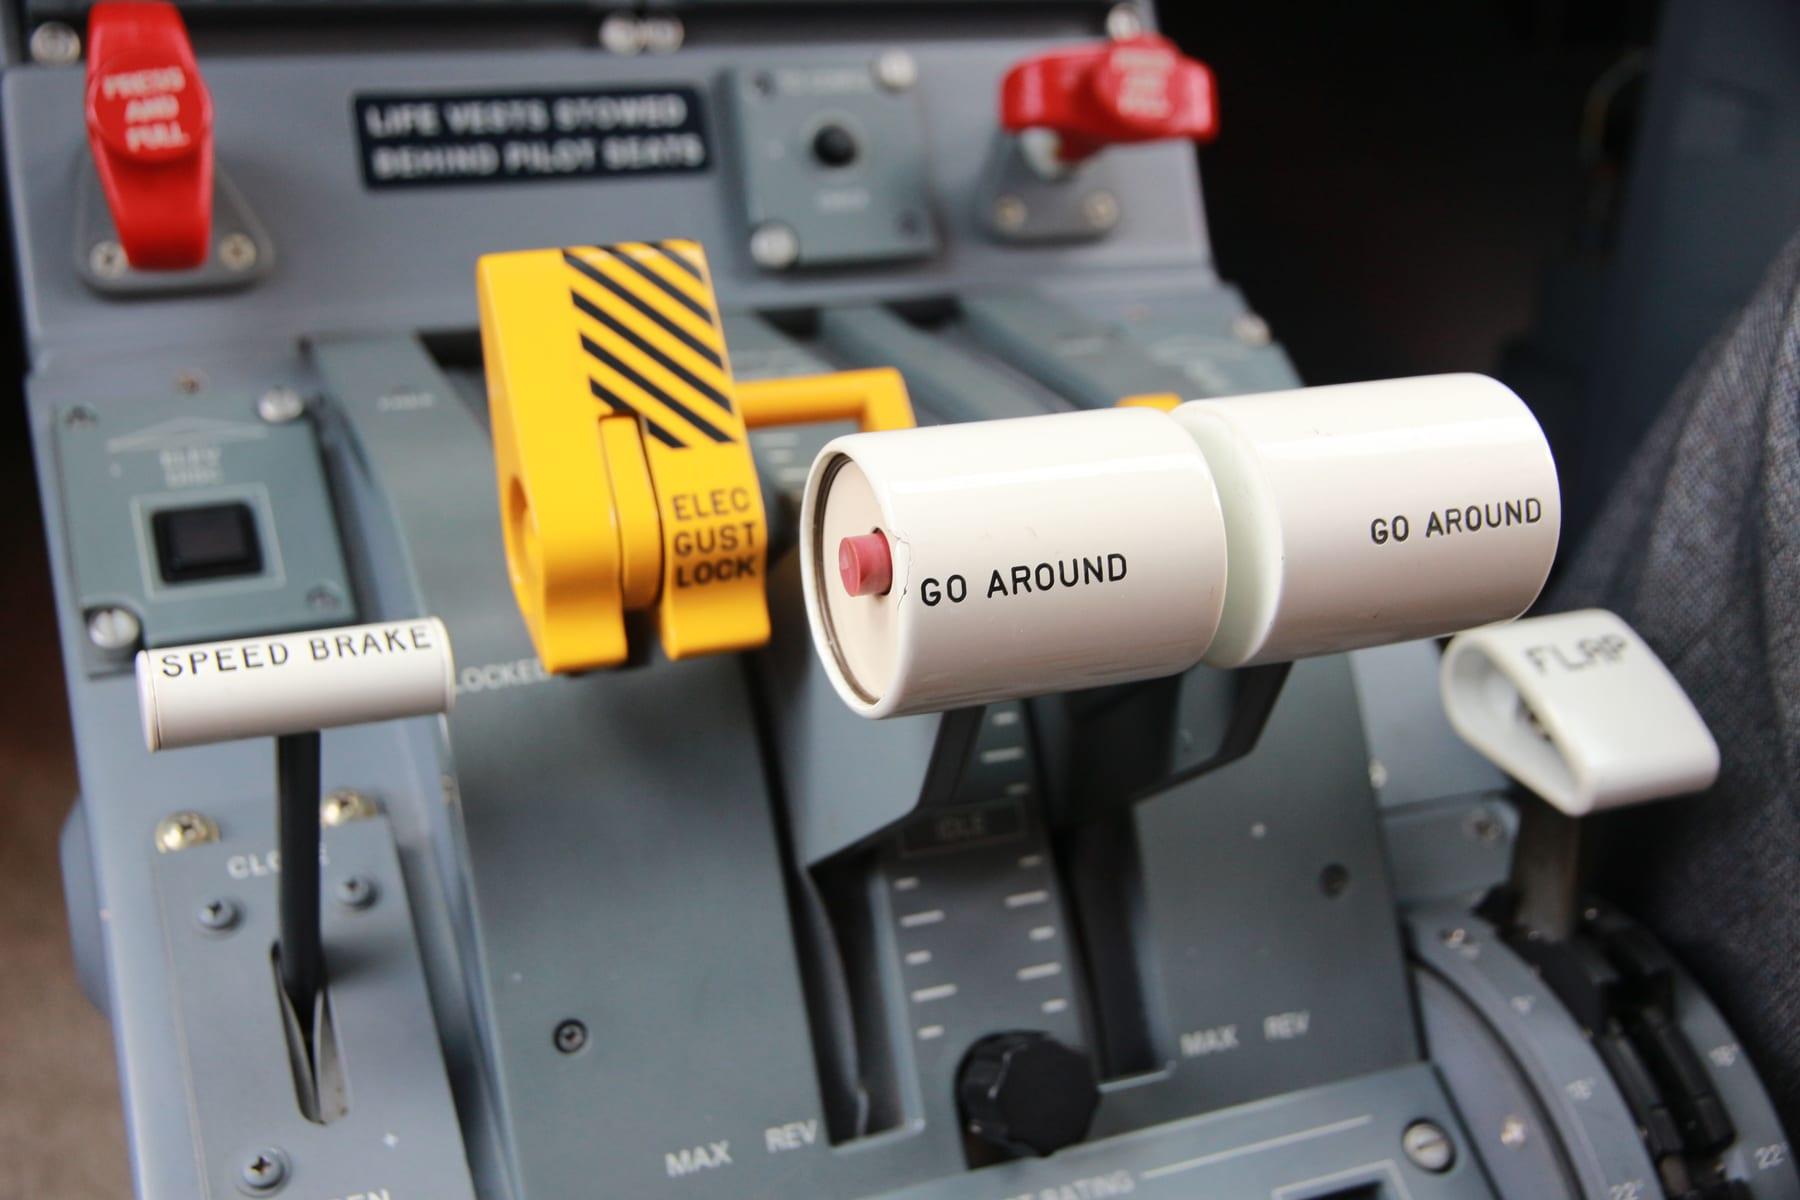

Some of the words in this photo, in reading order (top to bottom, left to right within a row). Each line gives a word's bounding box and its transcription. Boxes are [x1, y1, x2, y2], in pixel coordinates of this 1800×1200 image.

[365, 102, 437, 138] LIFE
[444, 98, 549, 135] VESTS
[553, 94, 687, 132] STOWED
[373, 144, 499, 179] BEHIND
[504, 140, 596, 174] PILOT
[603, 133, 704, 170] SEATS
[672, 486, 751, 522] ELEC
[1370, 515, 1410, 546] GO
[1425, 497, 1543, 539] AROUND
[674, 521, 756, 558] GUST
[676, 554, 758, 588] LOCK
[920, 573, 967, 607] GO
[987, 553, 1128, 600] AROUND
[161, 643, 290, 677] SPEED
[309, 626, 432, 661] BRAKE
[1525, 634, 1628, 677] FLAP
[1181, 1023, 1239, 1057] MAX
[664, 1139, 733, 1178] MAX
[765, 1118, 818, 1153] REV
